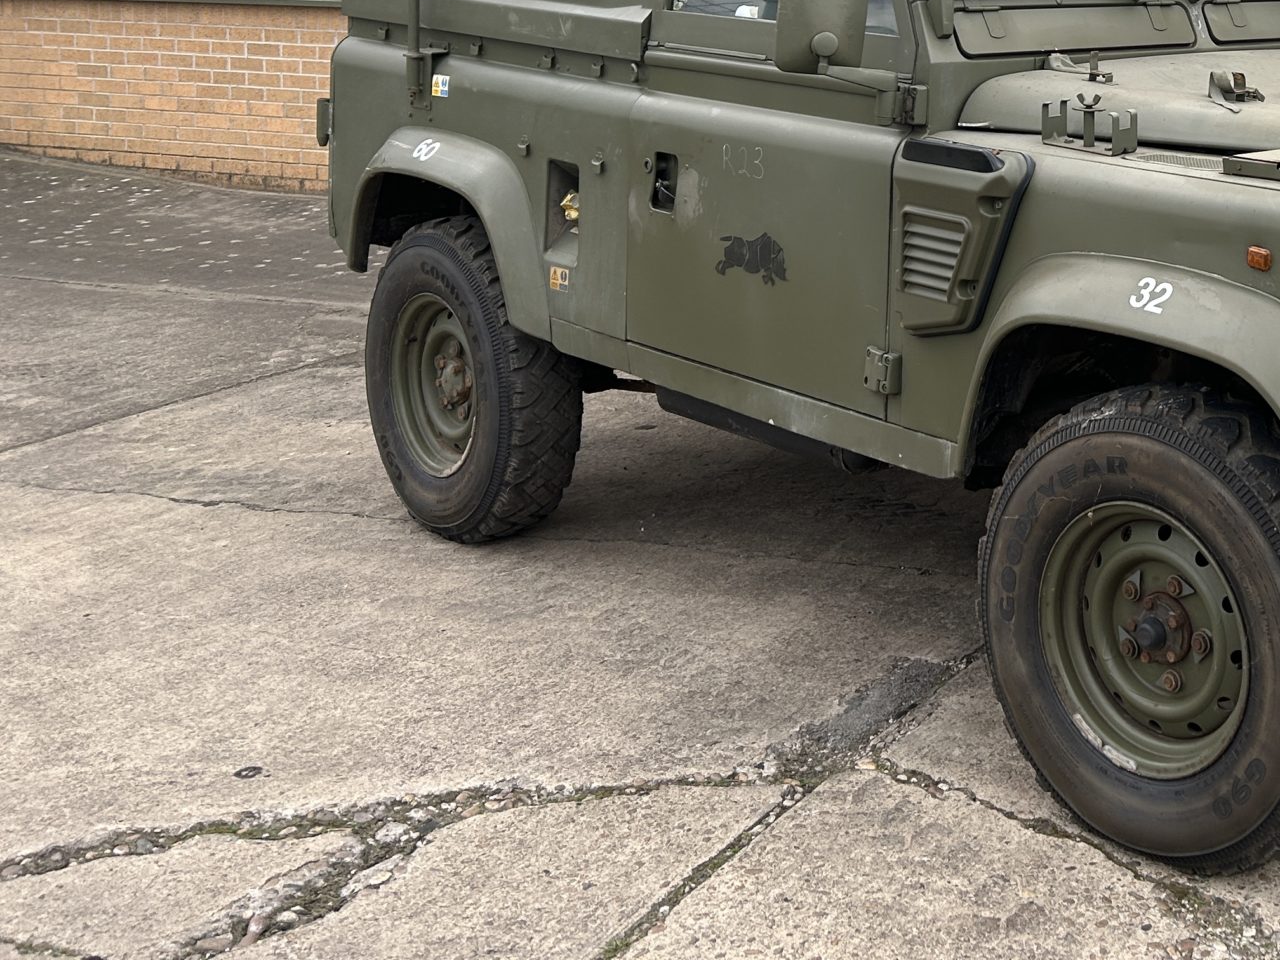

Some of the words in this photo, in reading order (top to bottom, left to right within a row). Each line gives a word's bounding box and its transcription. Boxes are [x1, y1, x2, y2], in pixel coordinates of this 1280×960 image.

[412, 138, 441, 162] 60
[721, 143, 765, 180] R23
[1129, 276, 1174, 315] 32
[999, 454, 1129, 623] GOODYEAR
